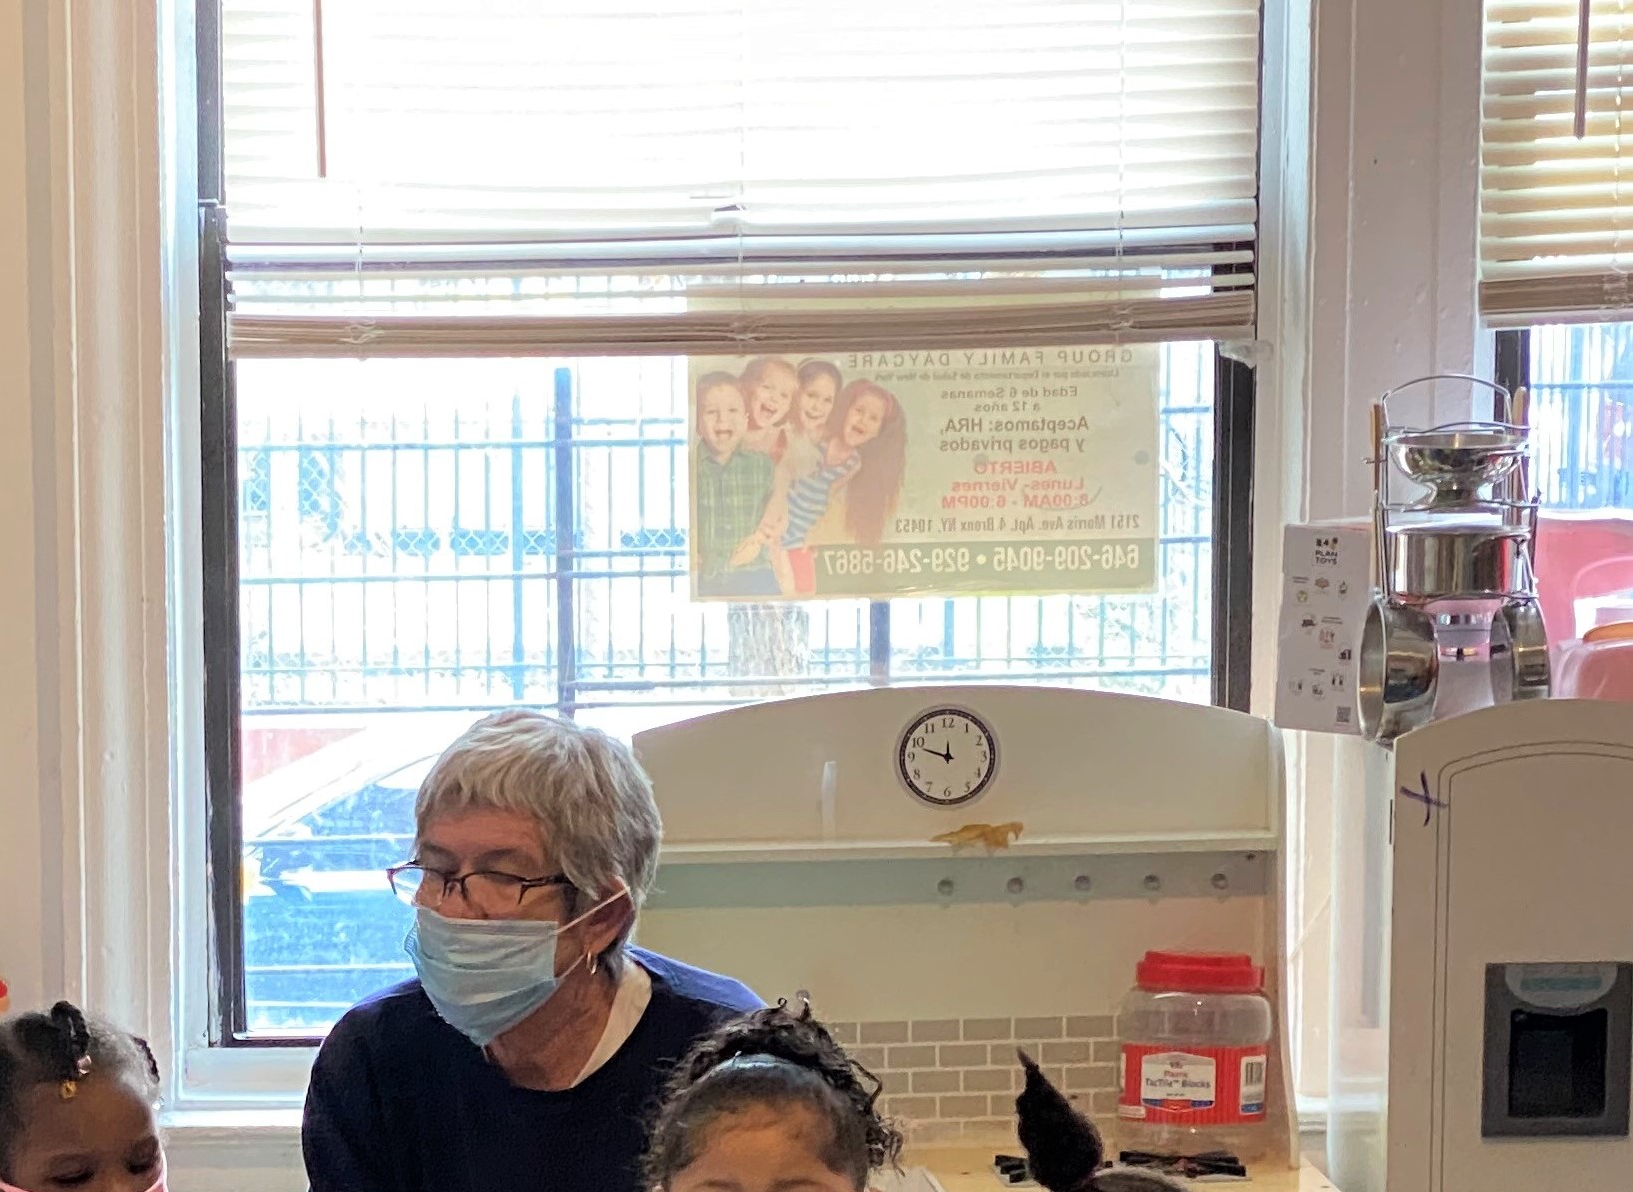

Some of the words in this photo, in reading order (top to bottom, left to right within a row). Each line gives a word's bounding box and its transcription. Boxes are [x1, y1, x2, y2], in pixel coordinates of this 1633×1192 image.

[924, 723, 935, 734] 11
[941, 718, 955, 728] 12
[964, 723, 969, 733] 1
[912, 736, 925, 748] 10
[976, 735, 983, 746] 2
[907, 752, 915, 762] 9
[981, 751, 988, 763] 3
[913, 769, 920, 779] 8
[926, 781, 933, 793] 7
[943, 786, 951, 797] 6
